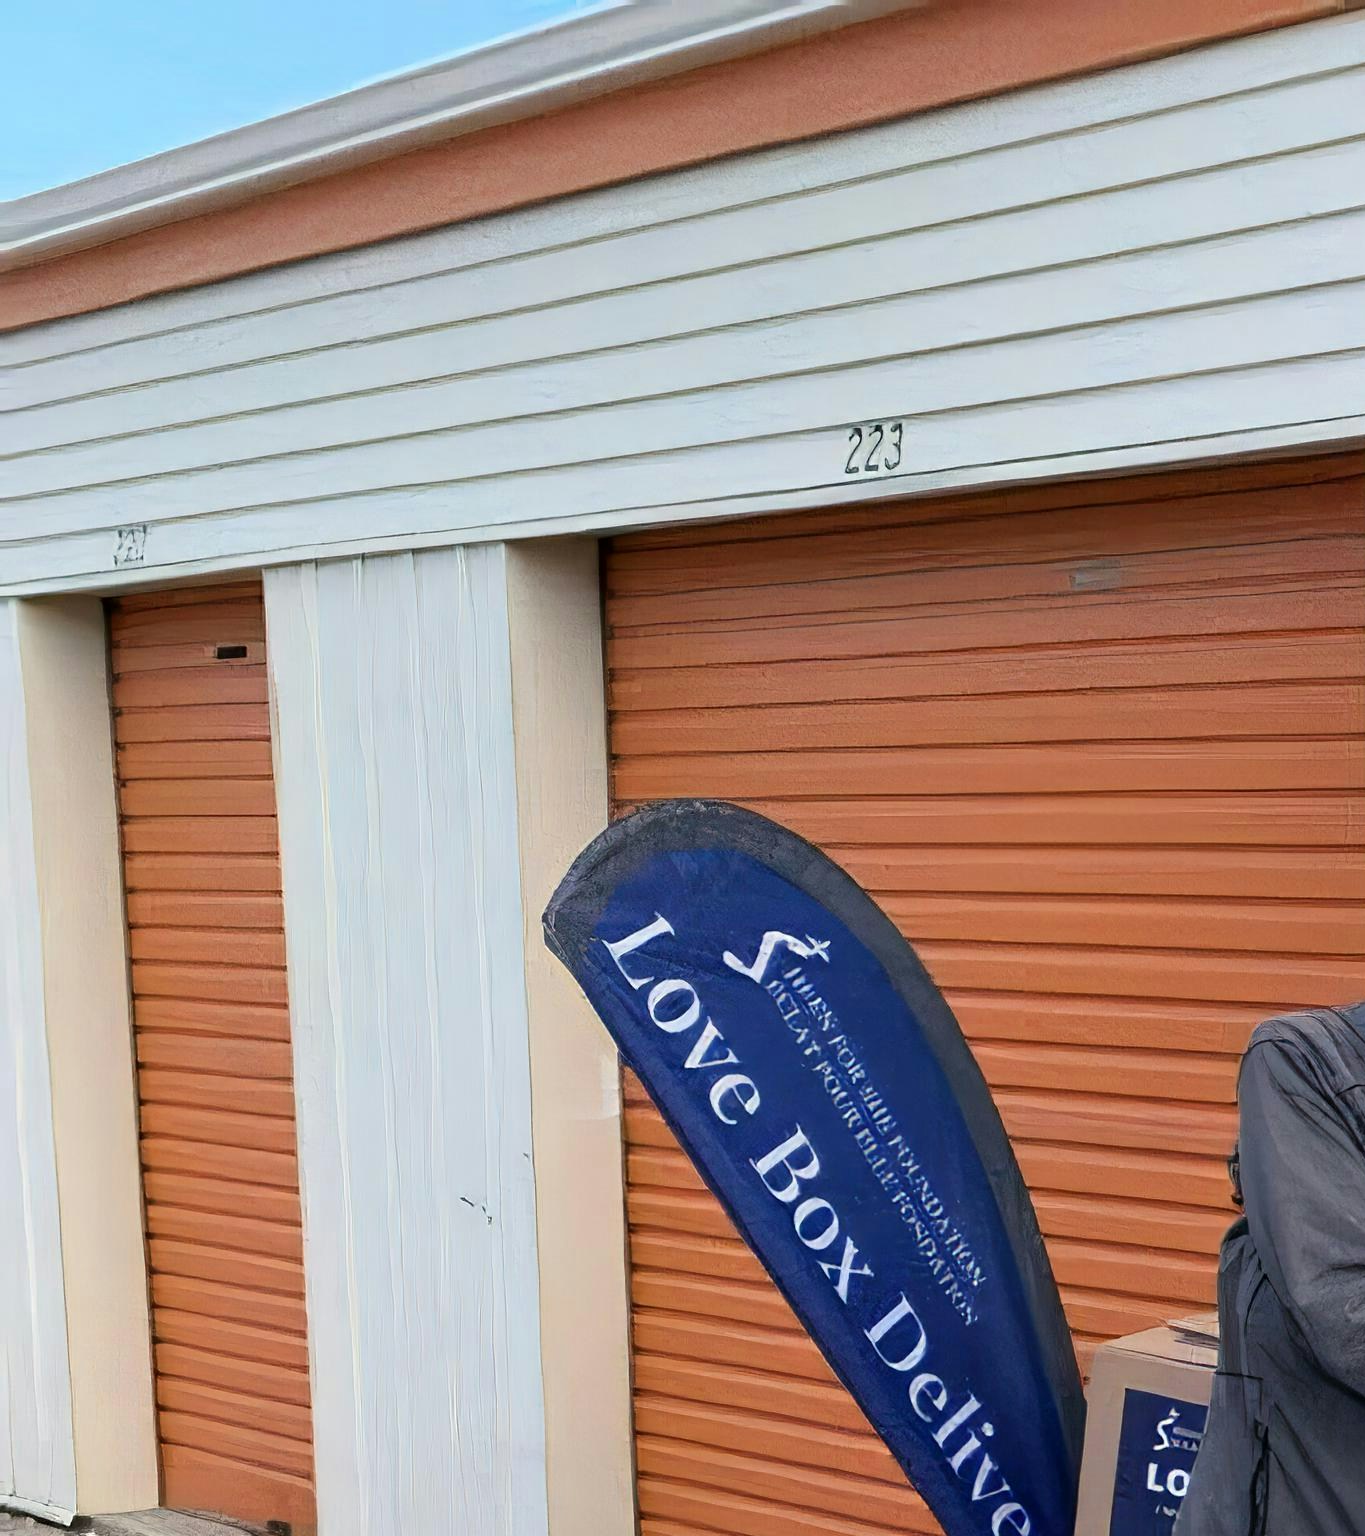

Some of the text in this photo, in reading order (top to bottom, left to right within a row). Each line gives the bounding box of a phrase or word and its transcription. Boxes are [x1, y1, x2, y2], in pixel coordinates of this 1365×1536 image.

[845, 423, 903, 474] 223
[602, 912, 761, 1126] Love
[749, 1123, 874, 1304] Box
